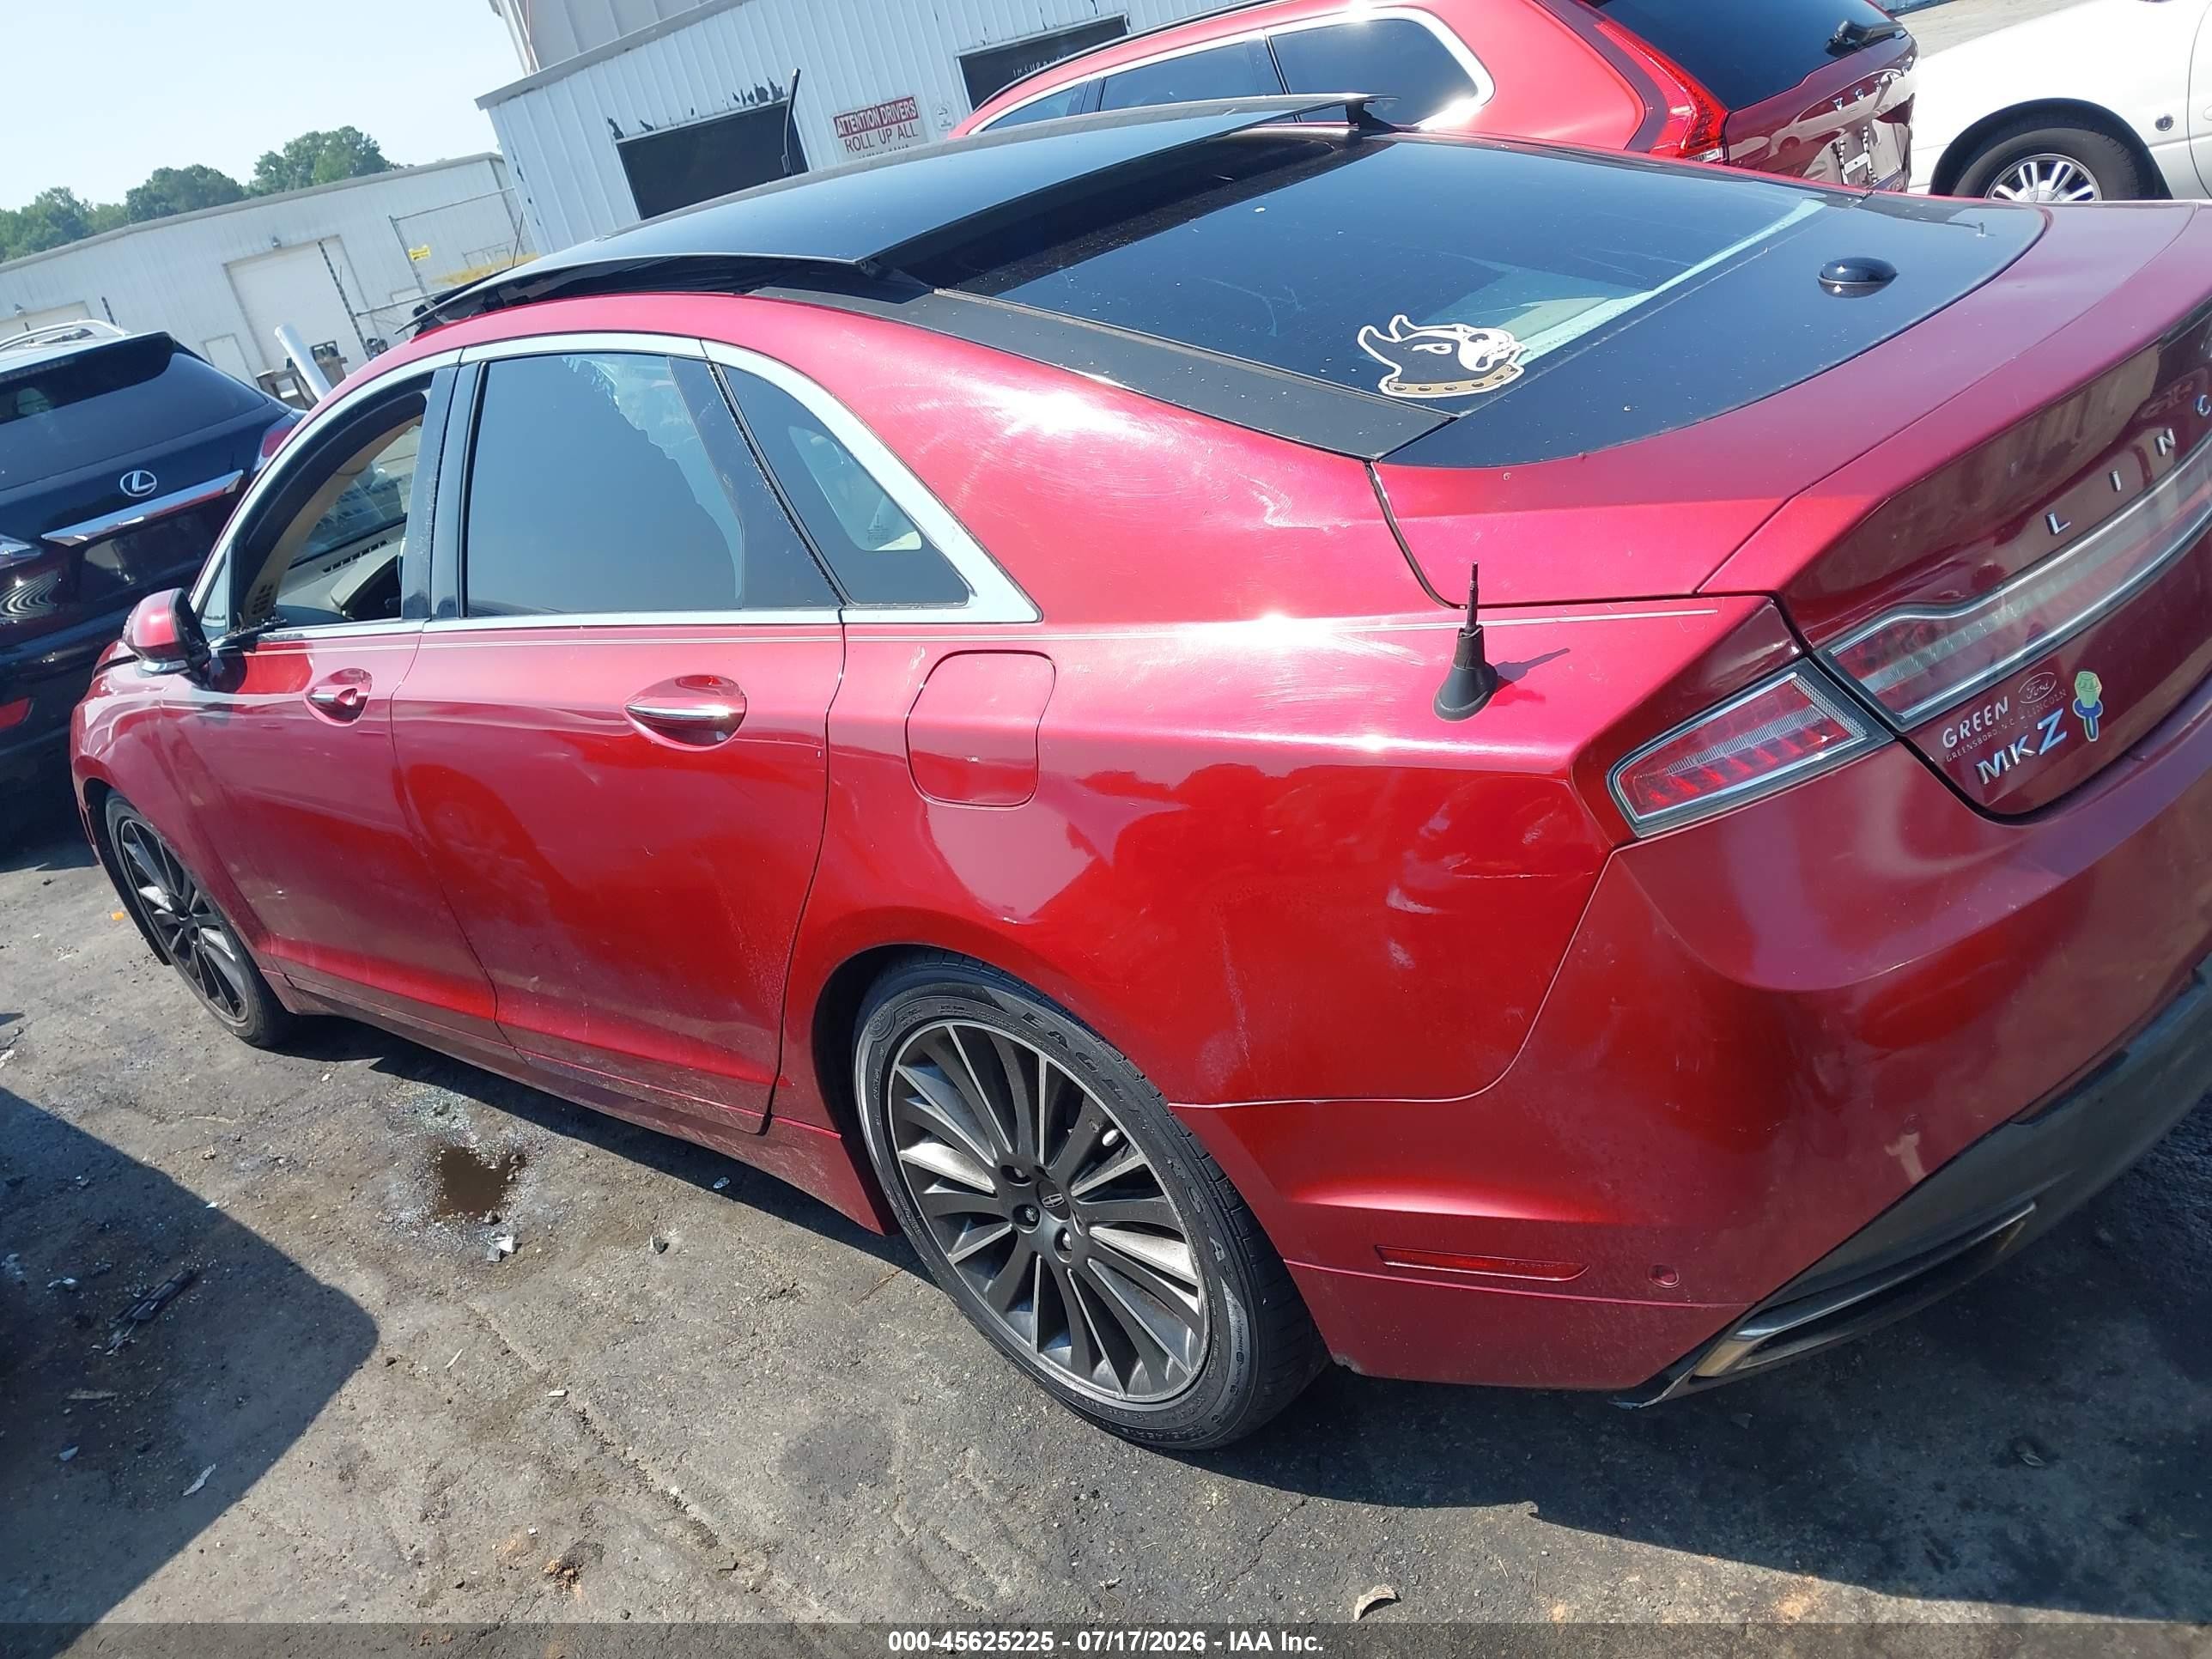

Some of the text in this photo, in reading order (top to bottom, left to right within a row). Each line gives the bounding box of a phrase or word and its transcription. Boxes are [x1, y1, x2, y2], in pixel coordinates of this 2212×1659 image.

[836, 100, 917, 137] ATTENTION DRIVERS
[844, 132, 875, 153] ROLL
[878, 128, 893, 144] UP
[897, 122, 919, 141] ALL
[1942, 696, 2008, 749] GREEN
[1975, 708, 2068, 785] MKZ
